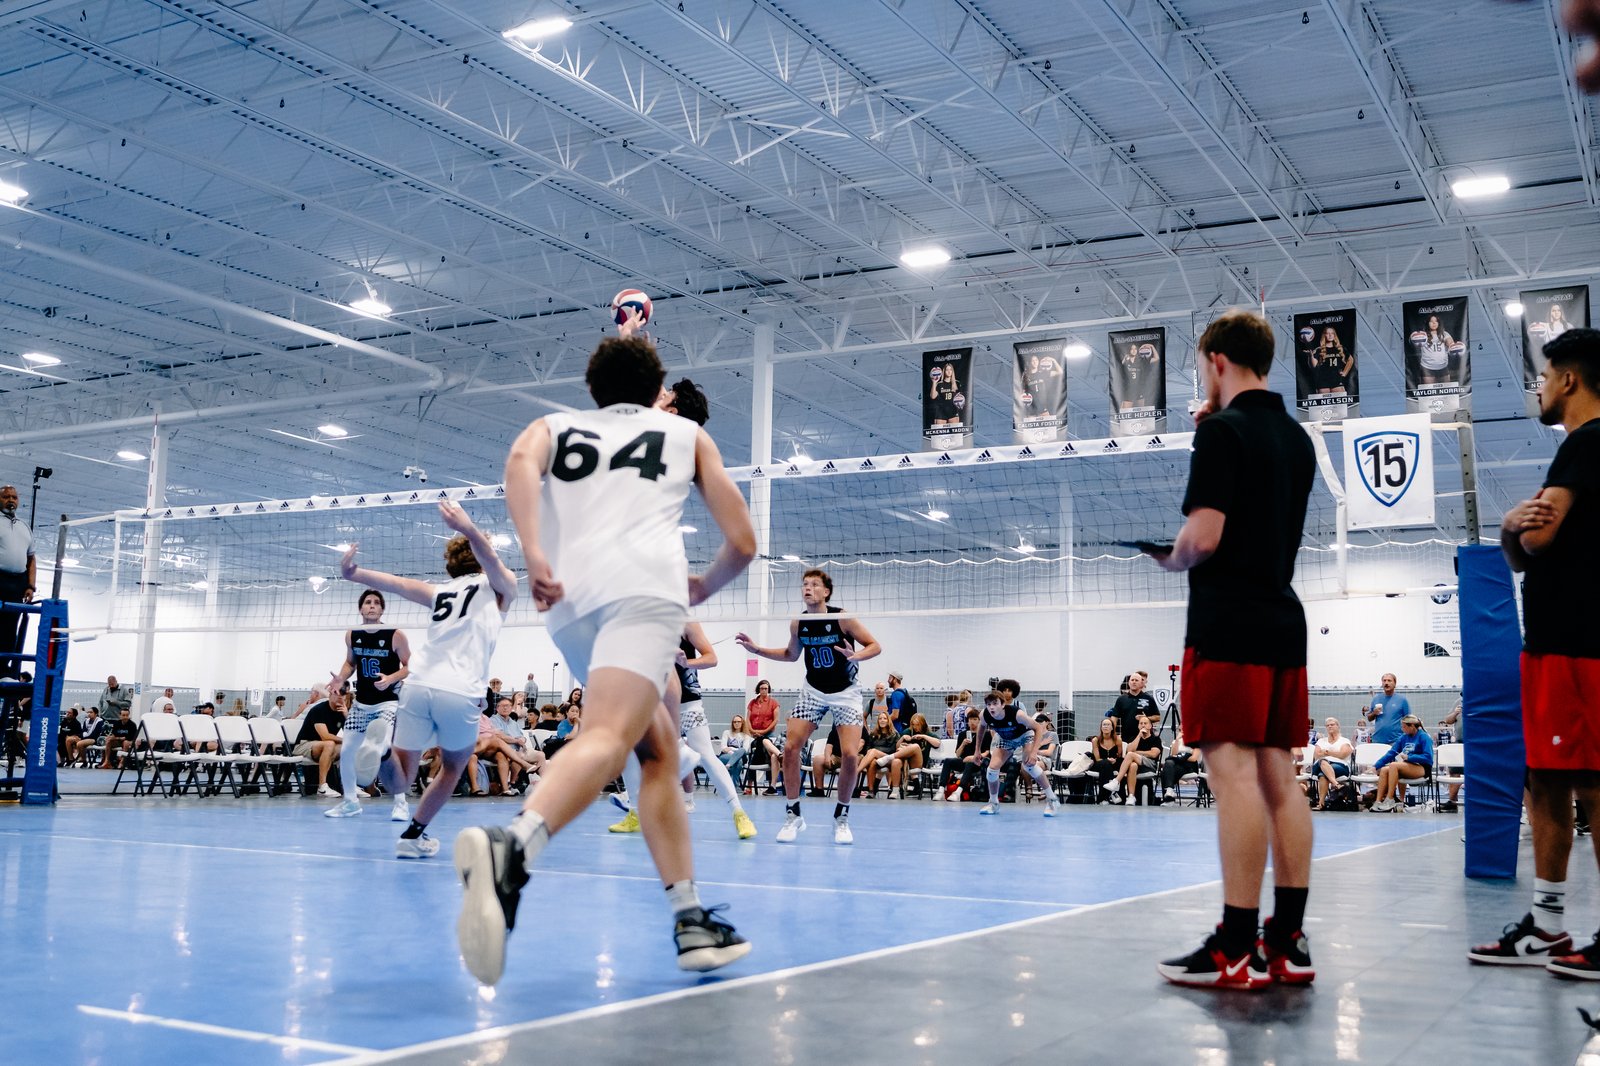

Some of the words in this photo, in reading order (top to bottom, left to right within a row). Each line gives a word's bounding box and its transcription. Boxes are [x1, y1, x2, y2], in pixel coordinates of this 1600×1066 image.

[1418, 304, 1454, 314] ALL-STAR
[1310, 316, 1344, 325] ALL-STAR
[1329, 357, 1338, 367] 14
[1131, 371, 1137, 379] 3
[1439, 387, 1465, 395] NORRIS
[1321, 397, 1354, 405] NELSON
[1134, 410, 1162, 418] HEPLER
[551, 426, 668, 482] 64
[1366, 442, 1407, 488] 15
[810, 646, 835, 668] 10
[361, 657, 381, 678] 16
[1159, 691, 1166, 702] 9
[41, 717, 49, 740] sports
[38, 739, 48, 767] imports
